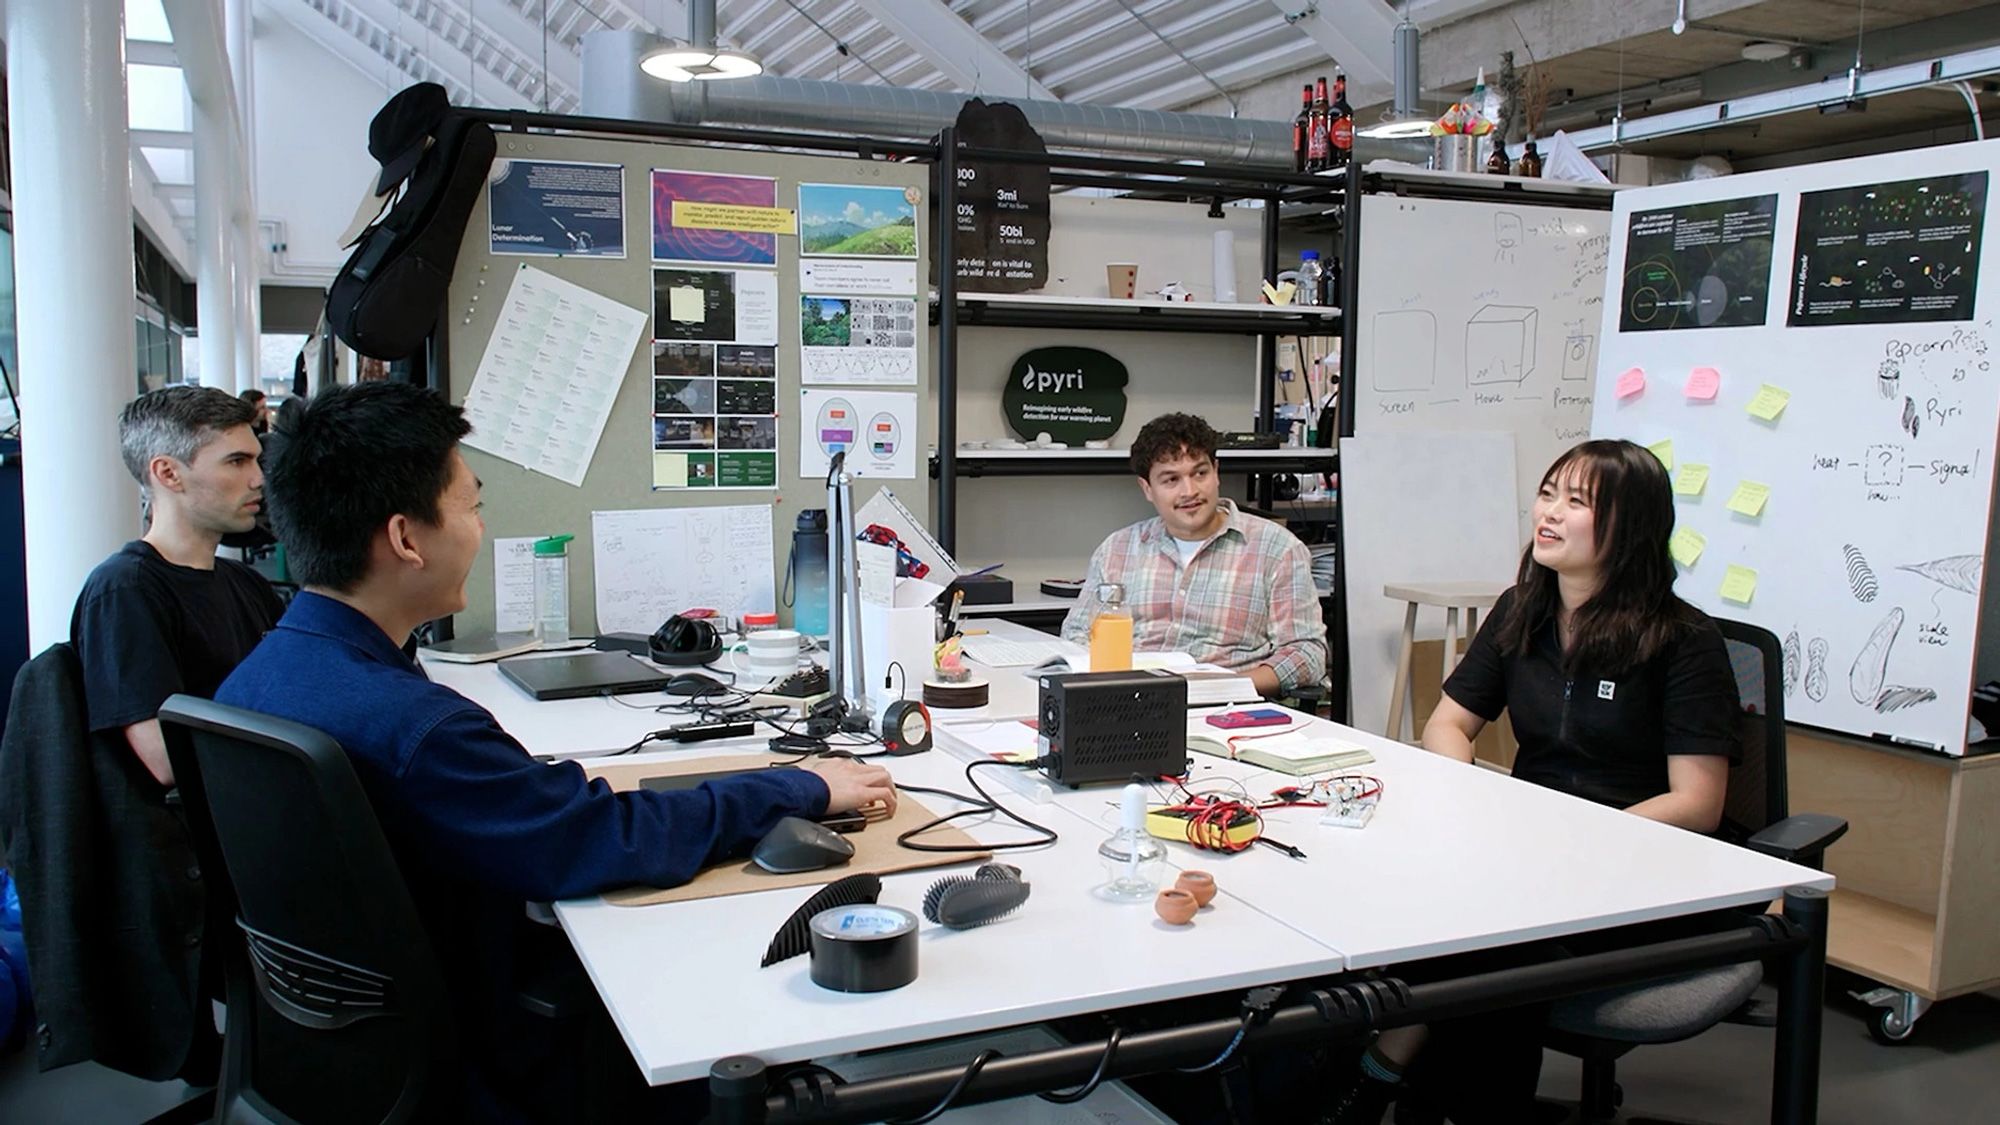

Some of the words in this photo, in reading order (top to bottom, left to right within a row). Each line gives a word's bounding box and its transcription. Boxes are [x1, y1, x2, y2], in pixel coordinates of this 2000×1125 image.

[997, 189, 1018, 201] 3mi
[492, 224, 513, 232] Lunar
[999, 225, 1023, 237] 50bi
[492, 233, 545, 243] Determination
[957, 258, 969, 267] arly
[1009, 260, 1024, 268] vital
[957, 269, 969, 277] urb
[1886, 329, 1964, 364] Popcorn?
[1038, 369, 1083, 393] pyri
[1379, 401, 1415, 415] Screen
[1926, 397, 1962, 426] Pyri
[1093, 415, 1112, 423] planet
[1929, 449, 1980, 484] Signal
